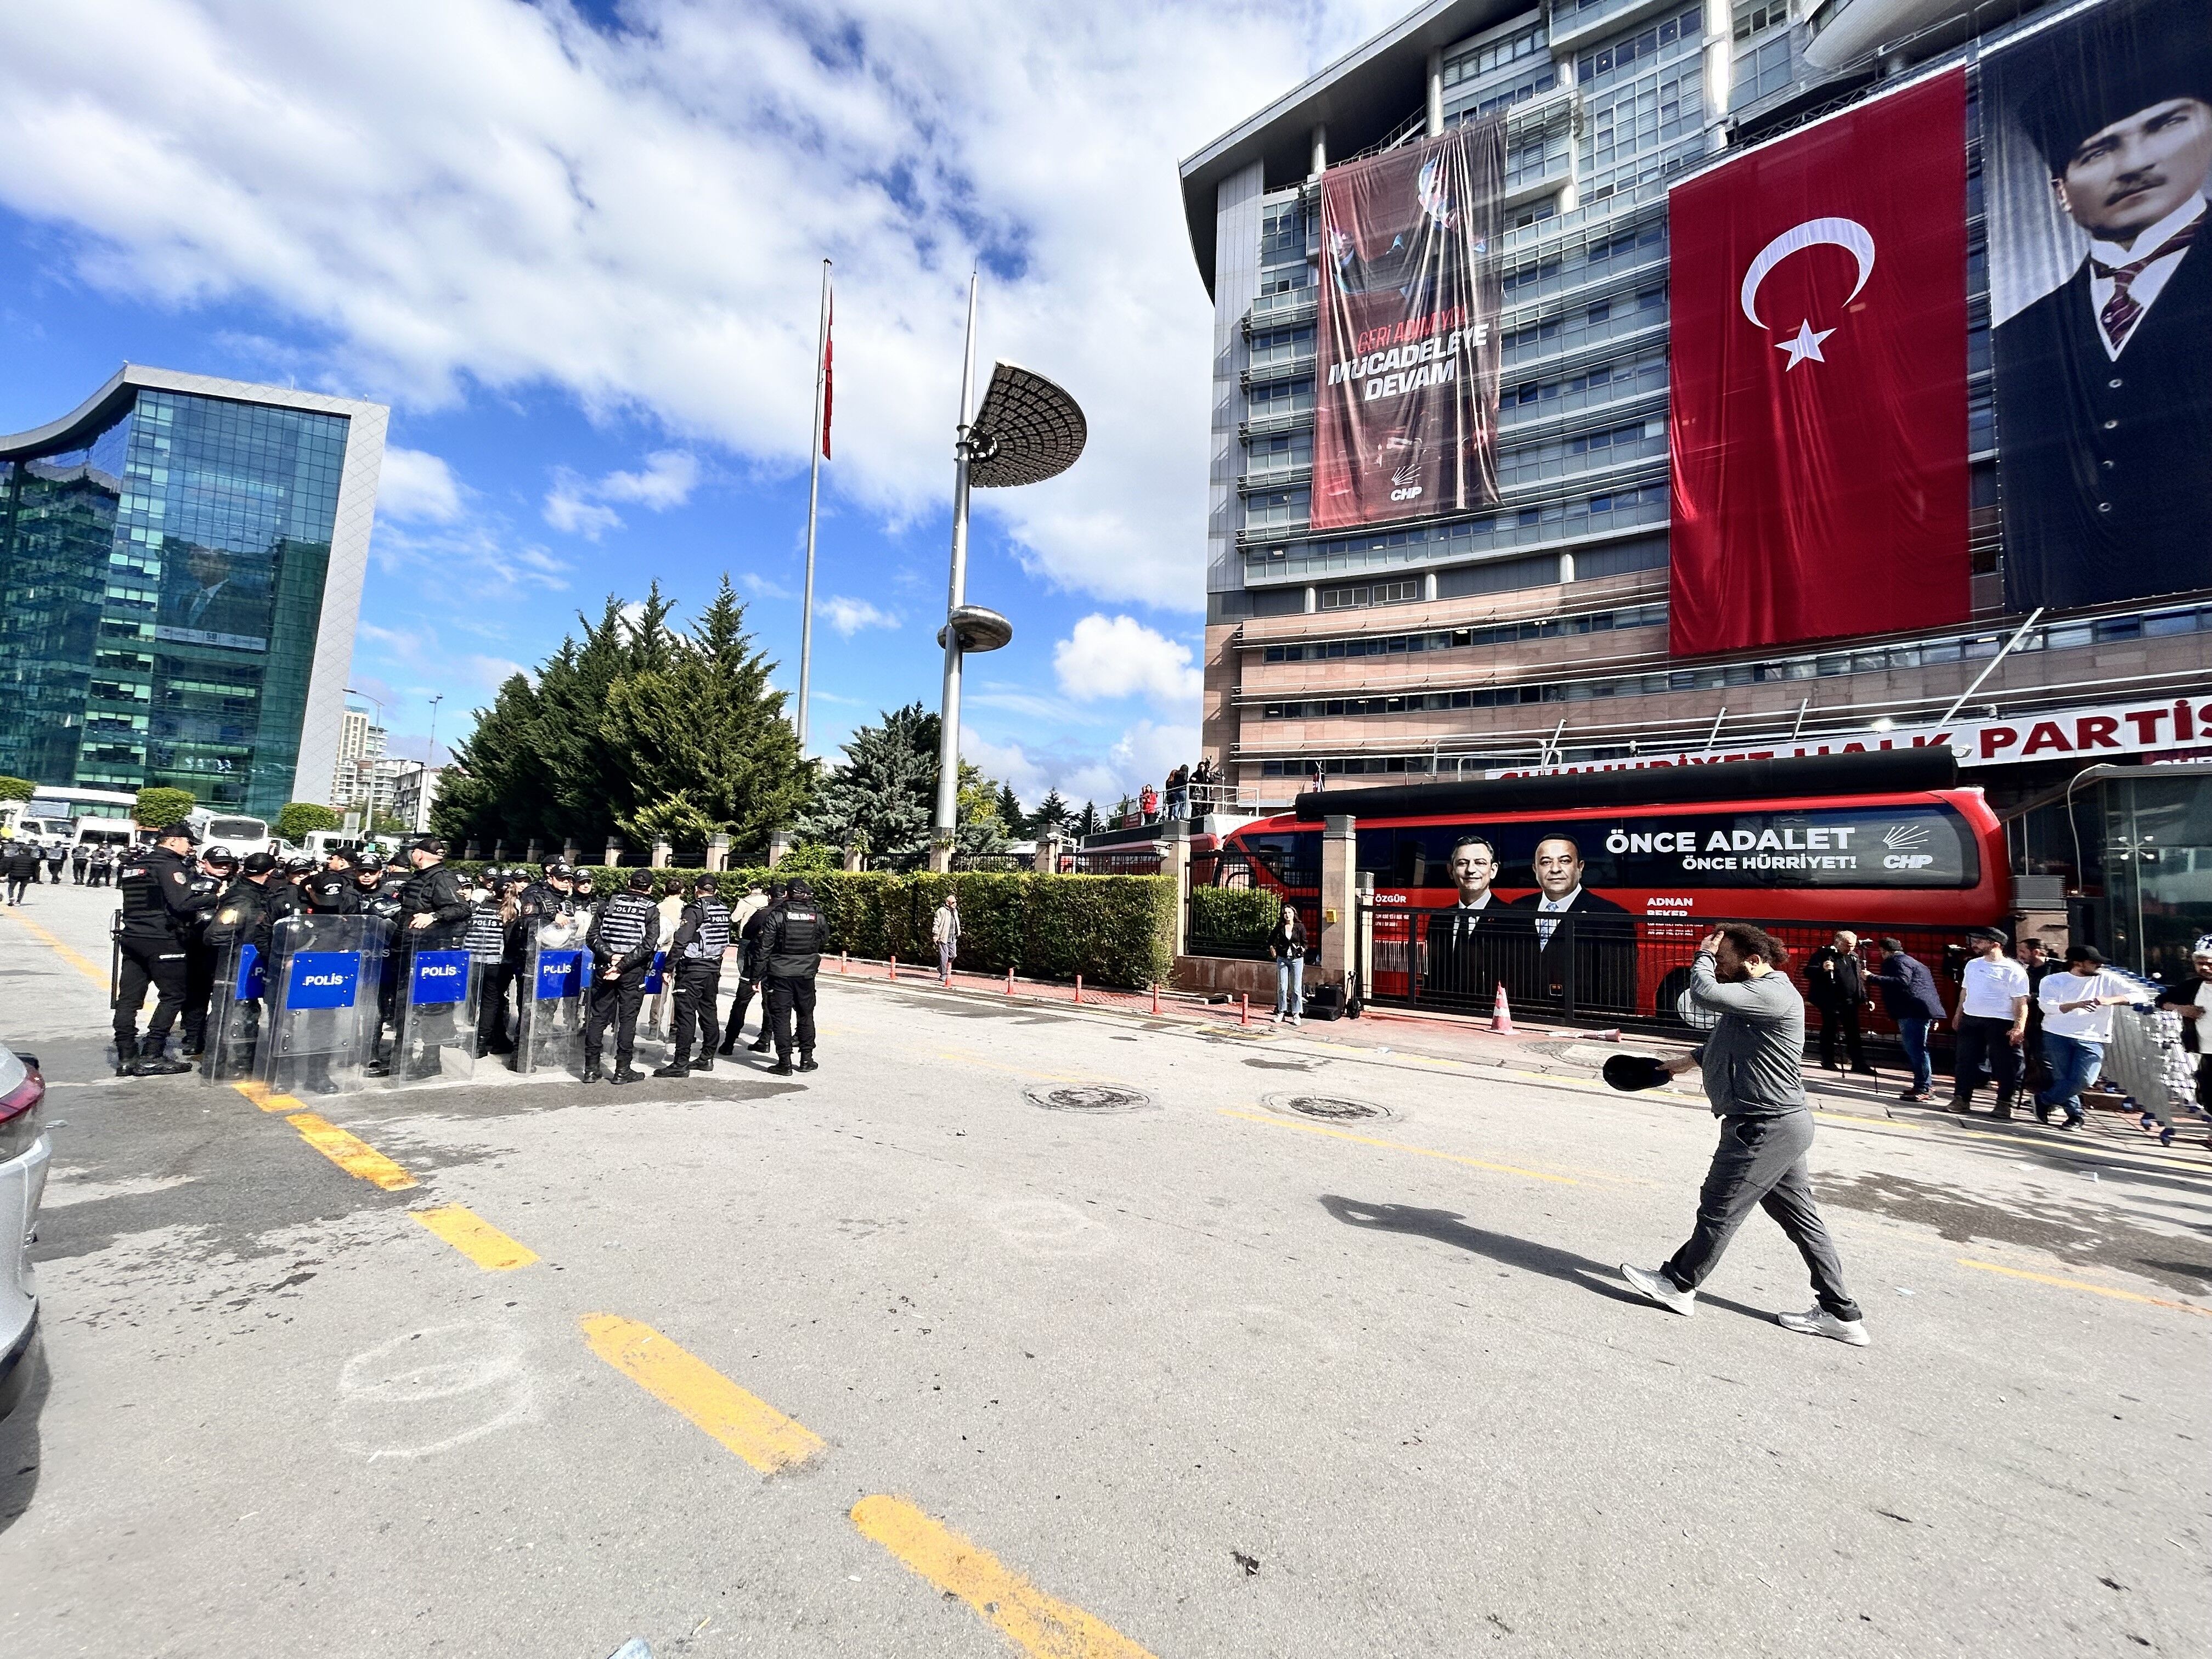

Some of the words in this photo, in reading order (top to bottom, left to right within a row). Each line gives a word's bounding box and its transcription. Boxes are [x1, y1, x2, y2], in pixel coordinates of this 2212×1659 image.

[1328, 323, 1489, 386] MÜCADELEYE
[1364, 357, 1455, 402] DEVAM
[1390, 486, 1423, 501] CHP
[1606, 829, 1696, 854] ÖNCE
[1705, 827, 1855, 851] ADALET
[1682, 855, 1737, 870] ÖNCE
[1742, 853, 1857, 870] HÜRRİYET!
[1883, 854, 1933, 869] CHP
[1375, 893, 1407, 903] ÖZGÜR
[1646, 898, 1693, 906] ADNAN
[421, 964, 458, 977] POLİS
[305, 973, 343, 986] POLİS
